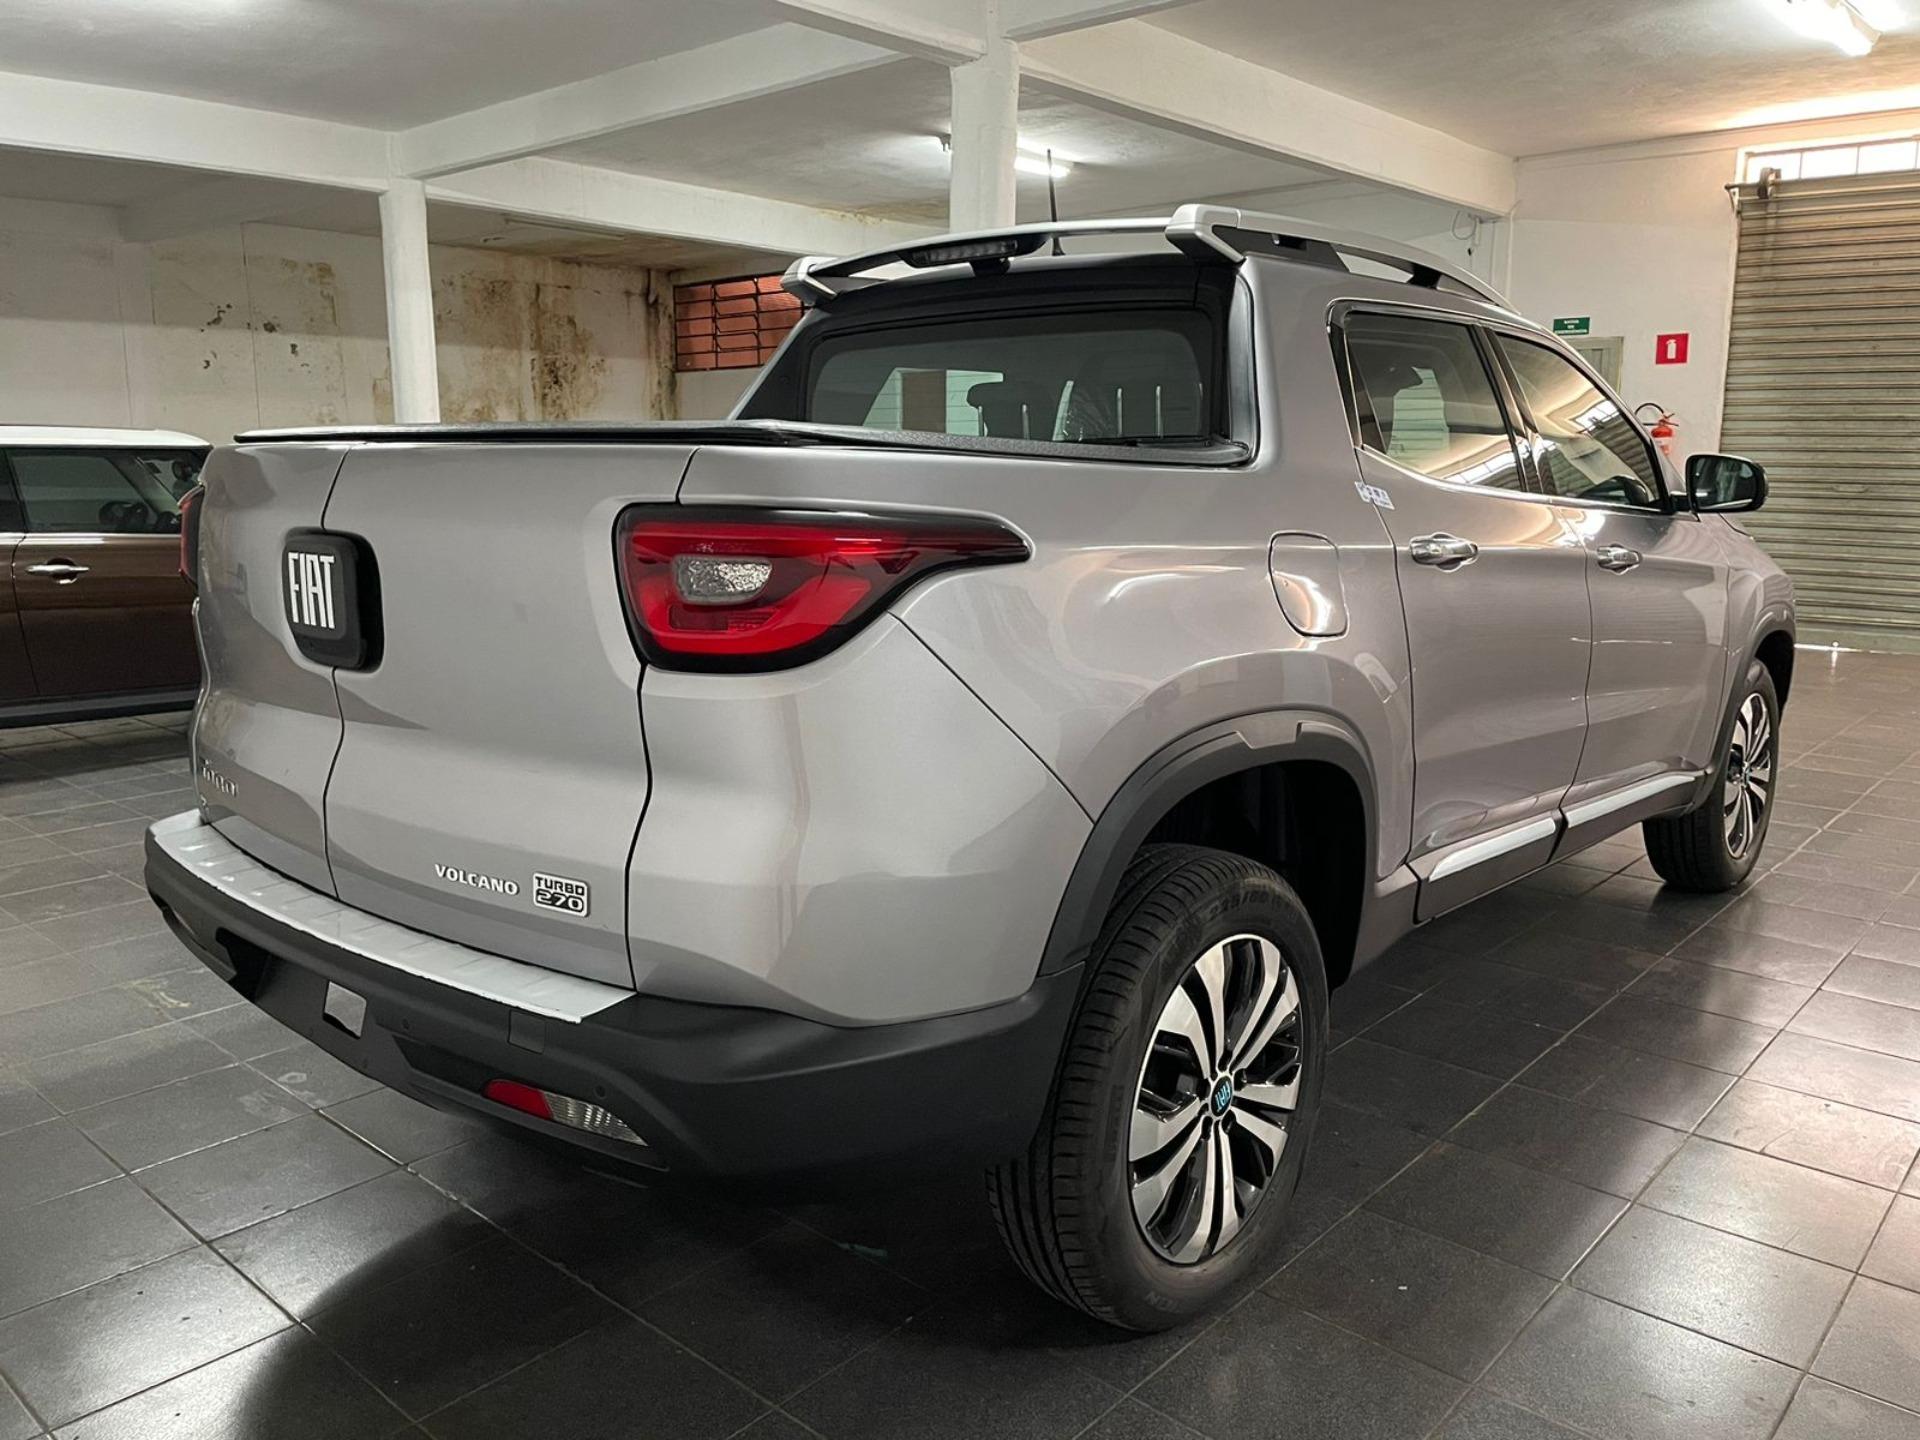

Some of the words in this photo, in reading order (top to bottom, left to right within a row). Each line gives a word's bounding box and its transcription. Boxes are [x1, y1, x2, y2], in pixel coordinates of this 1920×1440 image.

[287, 551, 336, 629] FIAT
[434, 863, 519, 896] VOLCANO
[535, 876, 585, 896] TURBO
[536, 888, 585, 913] 270
